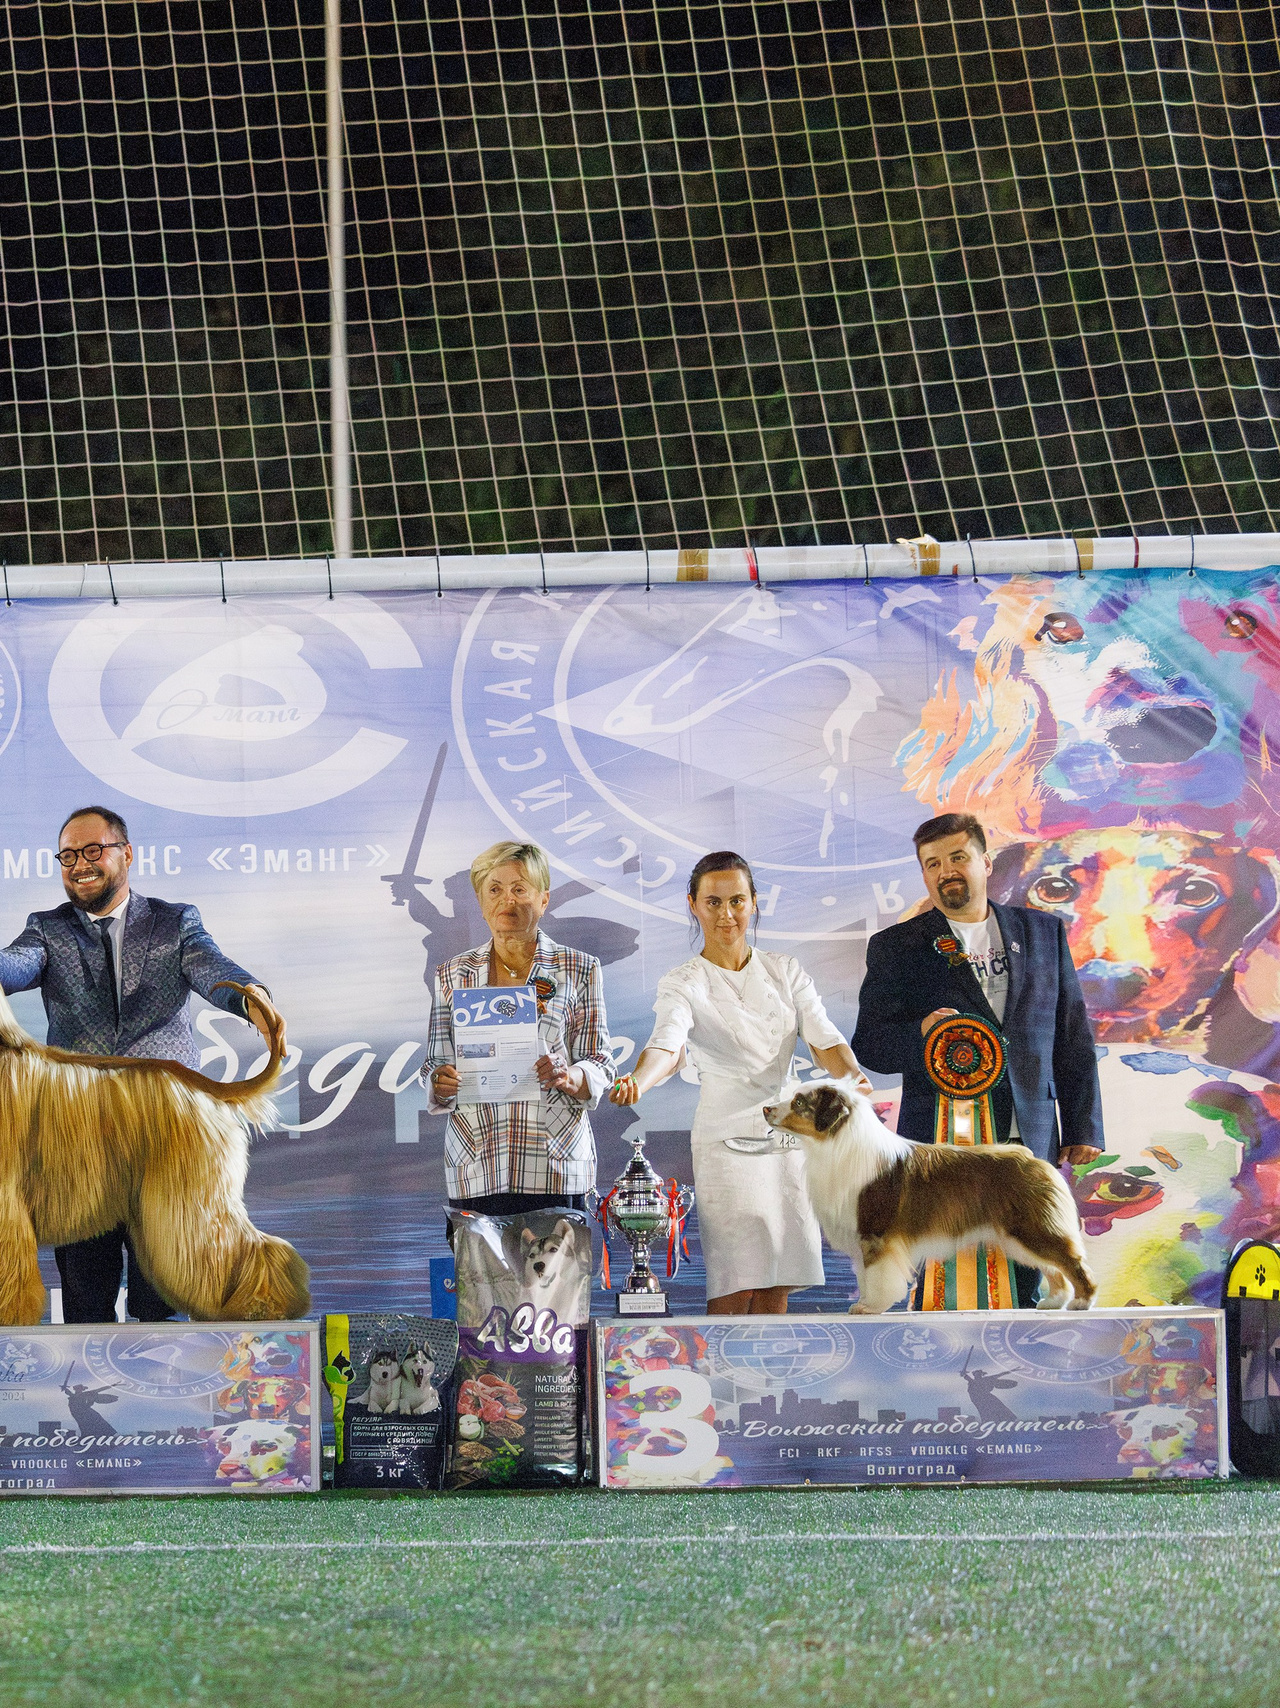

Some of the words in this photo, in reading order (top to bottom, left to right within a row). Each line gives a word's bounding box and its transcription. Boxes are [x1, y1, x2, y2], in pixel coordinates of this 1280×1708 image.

[206, 843, 392, 875] «Эманг»
[453, 987, 537, 1027] OZON
[627, 1369, 719, 1475] 3
[779, 1448, 800, 1459] FCI
[817, 1446, 841, 1457] RKF
[975, 1443, 1043, 1454] «EMANG»
[75, 1457, 143, 1468] «EMANG»
[867, 1463, 956, 1476] Волгоград
[376, 1465, 384, 1478] 3
